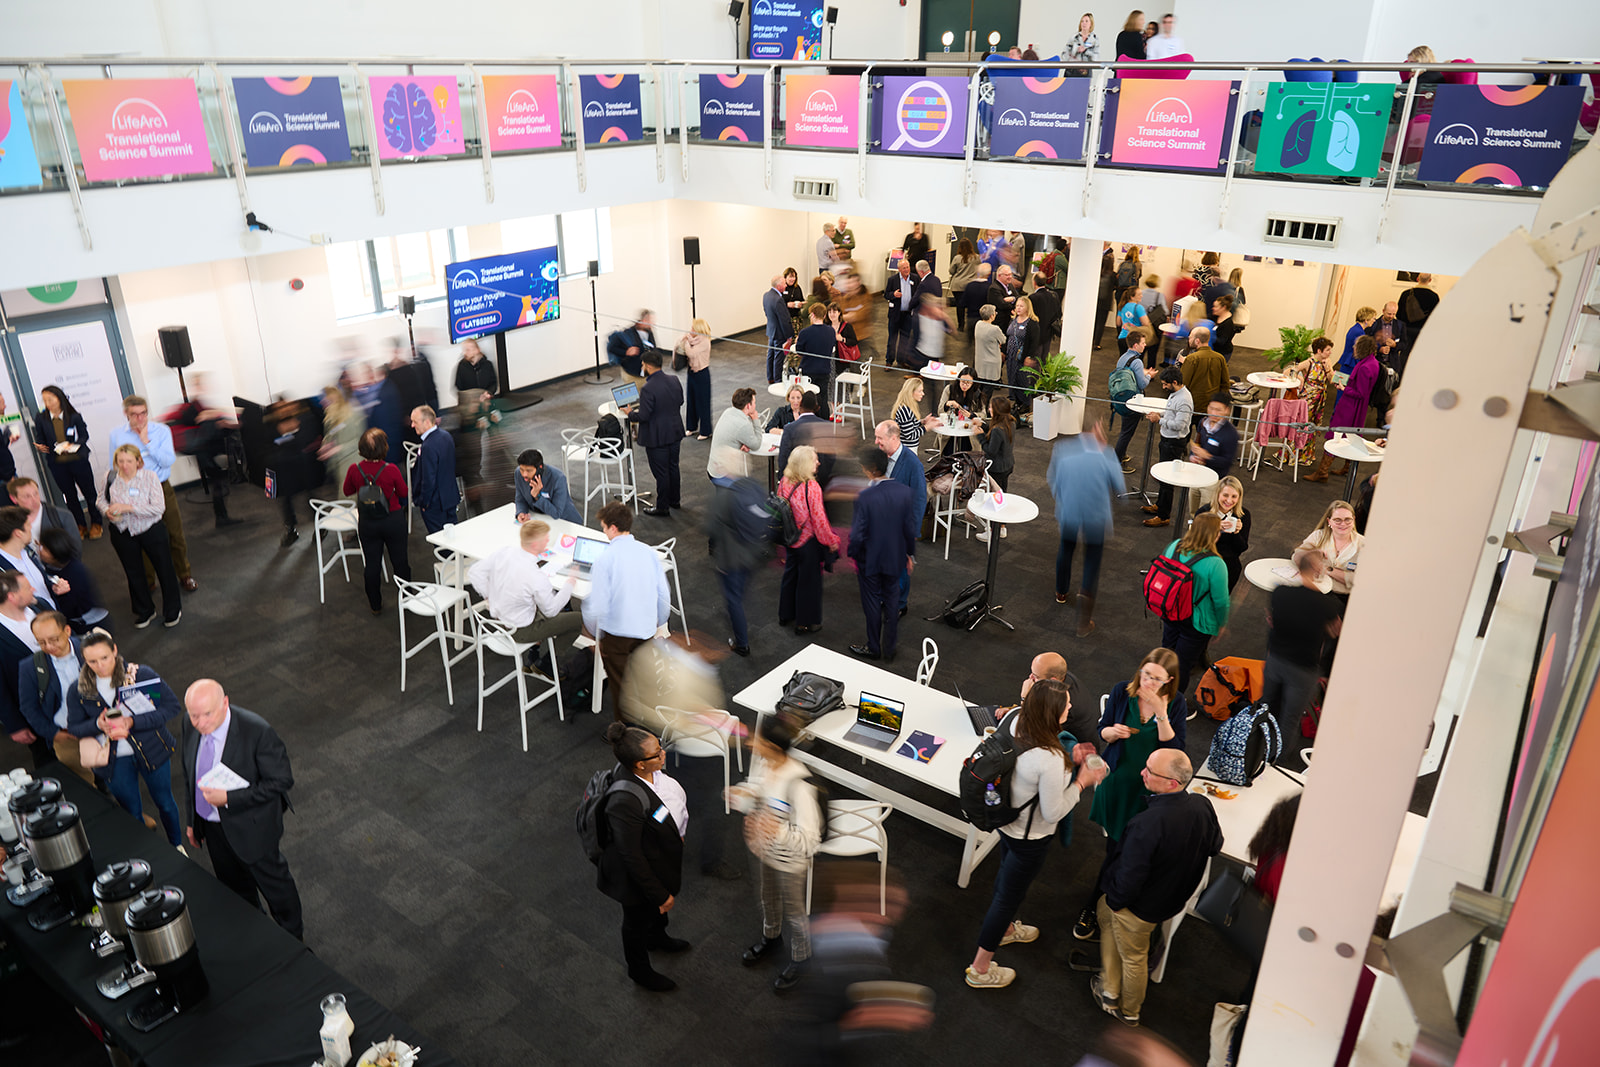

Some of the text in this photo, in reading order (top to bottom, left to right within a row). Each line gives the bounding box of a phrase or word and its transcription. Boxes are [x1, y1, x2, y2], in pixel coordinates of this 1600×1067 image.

[510, 102, 535, 113] LifeArc
[809, 101, 834, 111] LifeArc
[284, 112, 327, 122] Translational
[586, 110, 603, 118] LifeArc
[801, 113, 843, 123] Translational
[1030, 112, 1070, 120] Translational
[1151, 112, 1188, 123] LifeArc
[116, 115, 162, 130] LifeArc
[502, 114, 545, 126] Translational
[1002, 117, 1024, 126] LifeArc
[1029, 119, 1080, 128] Science Summit
[252, 122, 280, 134] LifeArc
[286, 120, 340, 132] Science Summit
[498, 124, 551, 136] Science Summit
[795, 123, 848, 134] Science Summit
[1138, 126, 1199, 138] Translational
[1486, 127, 1548, 138] Translational
[106, 130, 181, 146] Translational
[1128, 137, 1206, 150] Science Summit
[1439, 135, 1474, 145] LifeArc
[1482, 138, 1561, 149] Science Summit
[99, 144, 193, 160] Science Summit
[481, 264, 515, 276] Translational
[481, 270, 524, 284] Science Summit
[454, 292, 505, 307] Share your thoughts
[462, 303, 485, 313] LinkedIn
